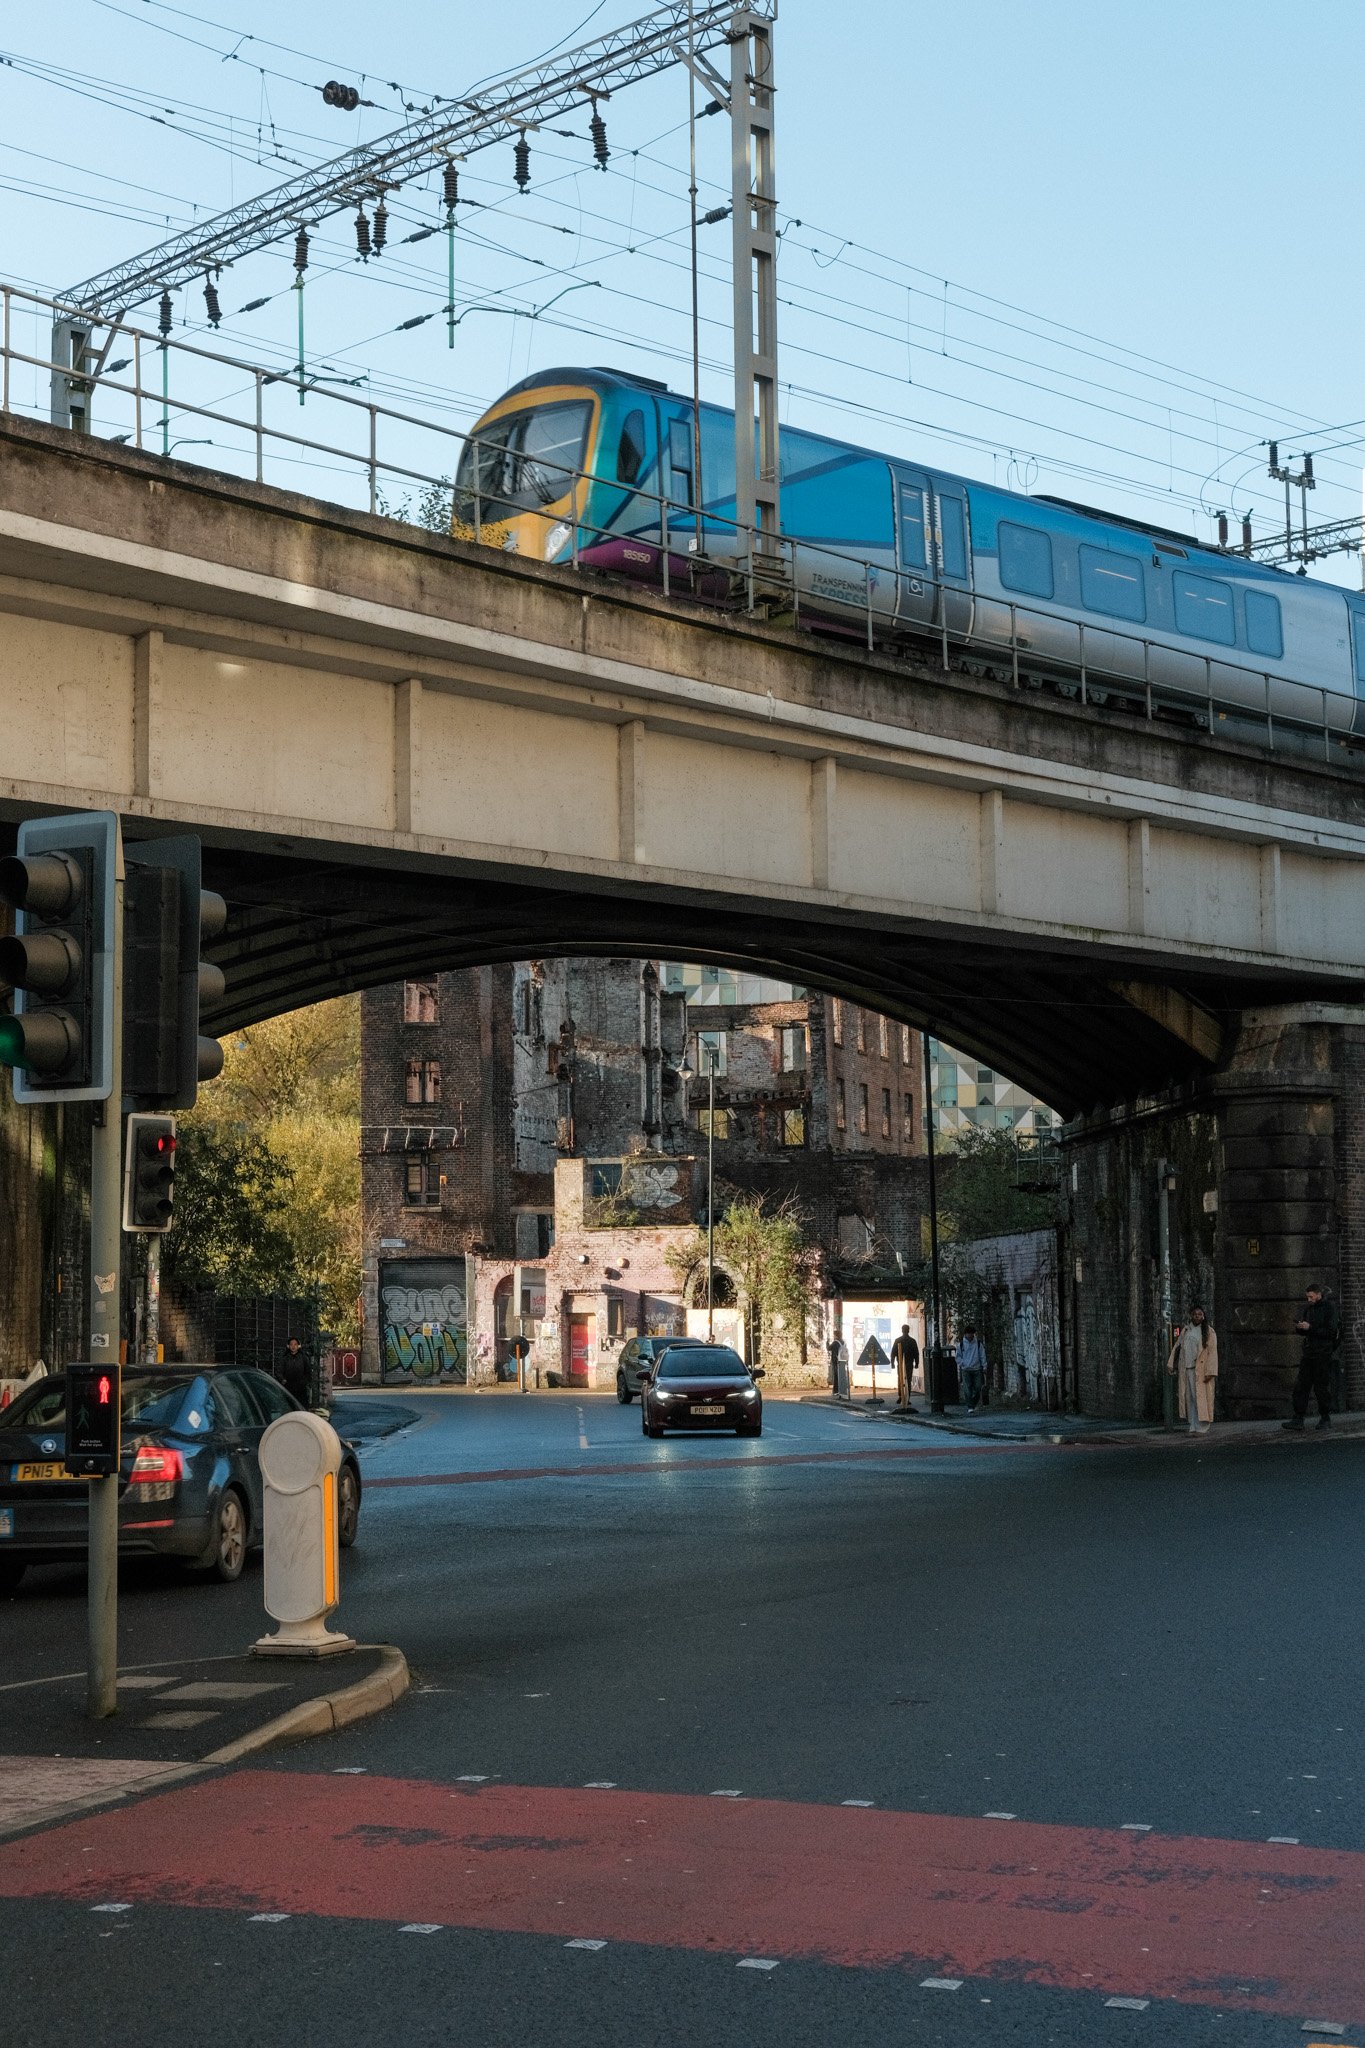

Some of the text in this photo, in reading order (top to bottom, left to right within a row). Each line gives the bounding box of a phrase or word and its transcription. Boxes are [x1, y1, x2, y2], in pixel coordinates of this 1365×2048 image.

[623, 549, 651, 563] 185150
[812, 573, 868, 594] TRANSPENNINE
[22, 1465, 53, 1479] PN15
